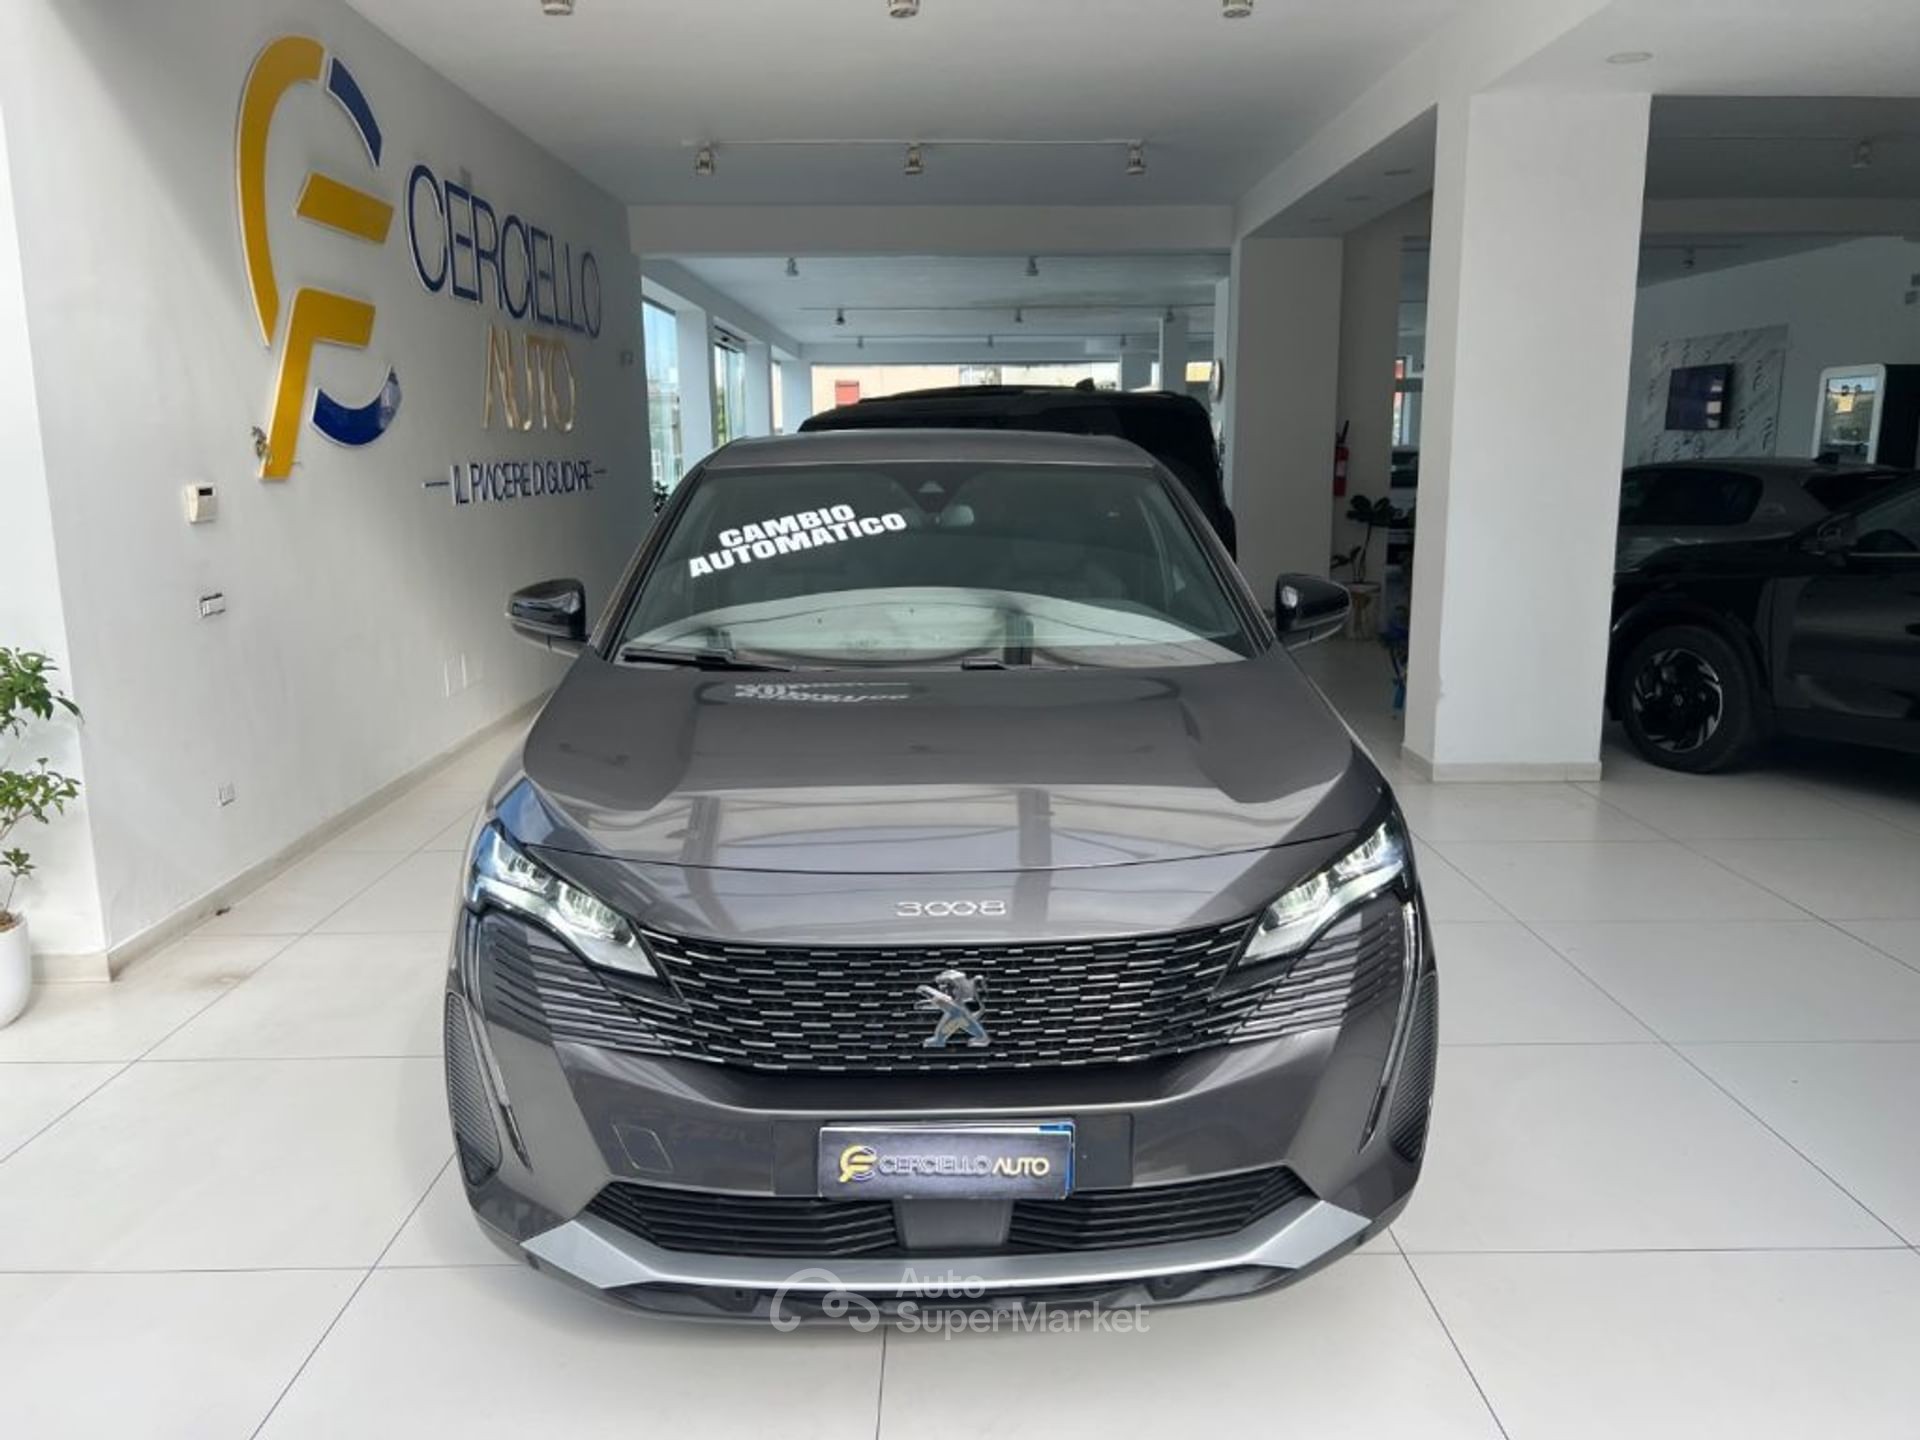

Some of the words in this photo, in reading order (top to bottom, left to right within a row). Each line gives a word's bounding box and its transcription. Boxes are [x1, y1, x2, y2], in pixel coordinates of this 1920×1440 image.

[407, 164, 601, 339] CERCIELLO
[482, 323, 576, 432] AUTO
[688, 512, 907, 578] AUTOMATICO
[718, 503, 856, 549] CAMBIO
[896, 900, 1006, 917] 3008
[879, 1154, 991, 1177] CERCIELLO
[992, 1156, 1050, 1177] AUTO
